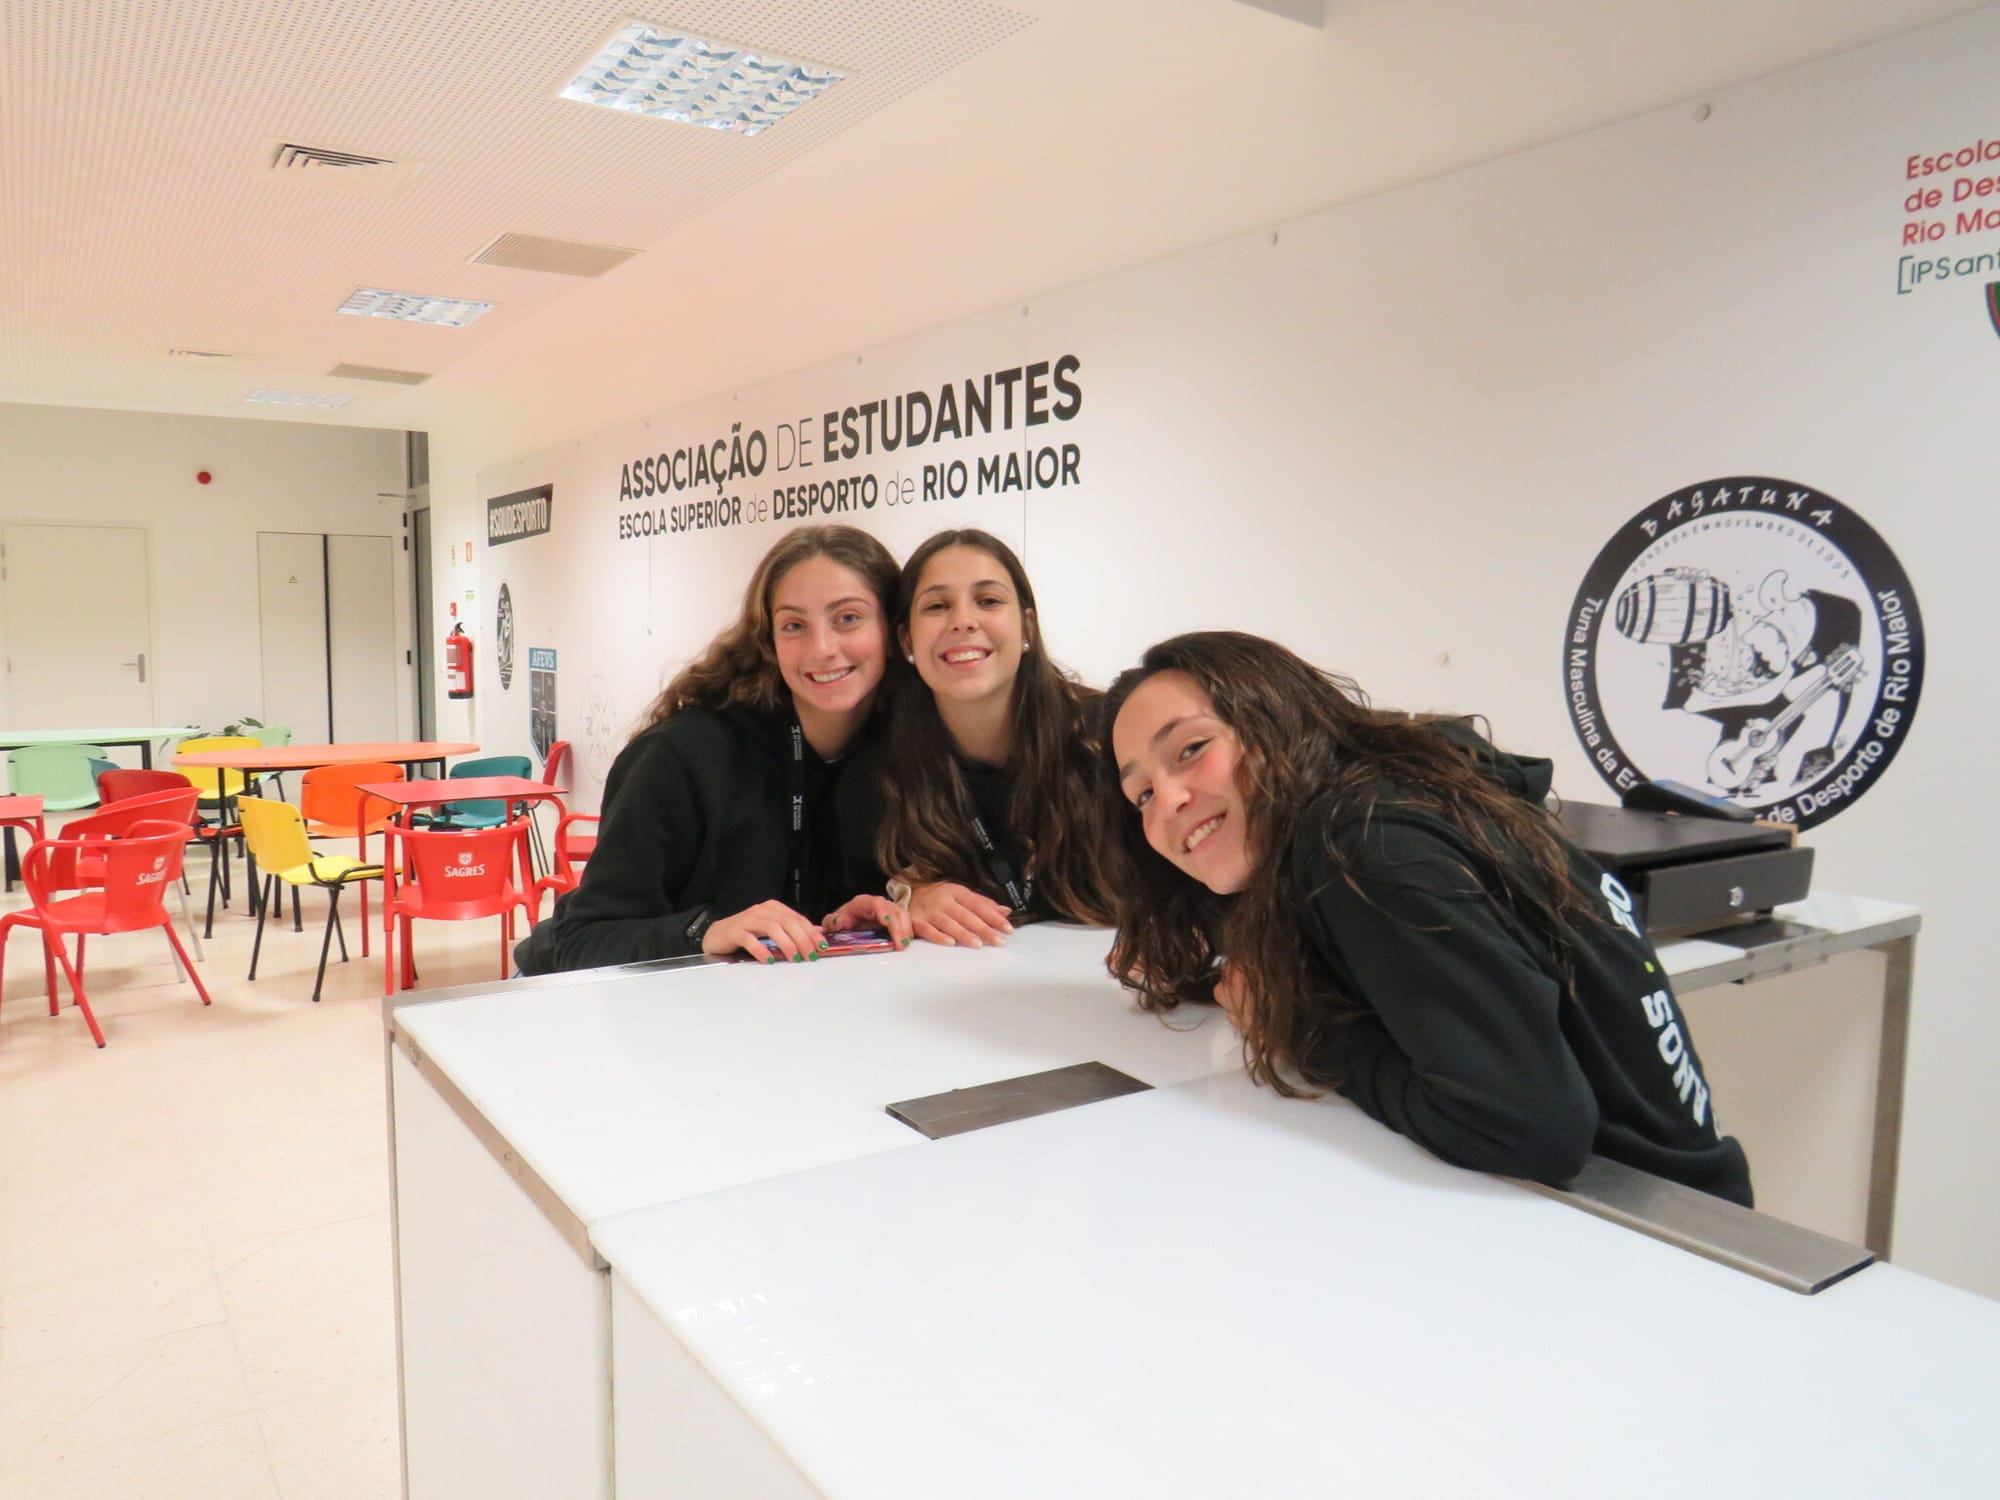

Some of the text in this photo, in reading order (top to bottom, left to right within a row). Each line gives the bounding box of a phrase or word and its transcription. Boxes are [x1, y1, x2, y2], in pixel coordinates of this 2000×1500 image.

[1904, 187, 1942, 213] de
[1903, 221, 1945, 246] Rio
[620, 354, 1082, 502] ASSOCIAÇÃO DE ESTUDANTES
[619, 443, 1081, 540] ESCOLA SUPERIOR de DESPORTO de RIO MAIOR
[1640, 486, 1833, 537] BAGATUNA
[1572, 597, 1604, 643] Tuna
[1877, 589, 1912, 656] Maior
[1570, 649, 1601, 748] Masculina
[1882, 658, 1912, 703] Rio
[1864, 707, 1901, 739] de
[1596, 748, 1618, 774] da
[1798, 739, 1884, 816] Desporto
[1767, 806, 1797, 825] de
[443, 864, 486, 878] SAGRES
